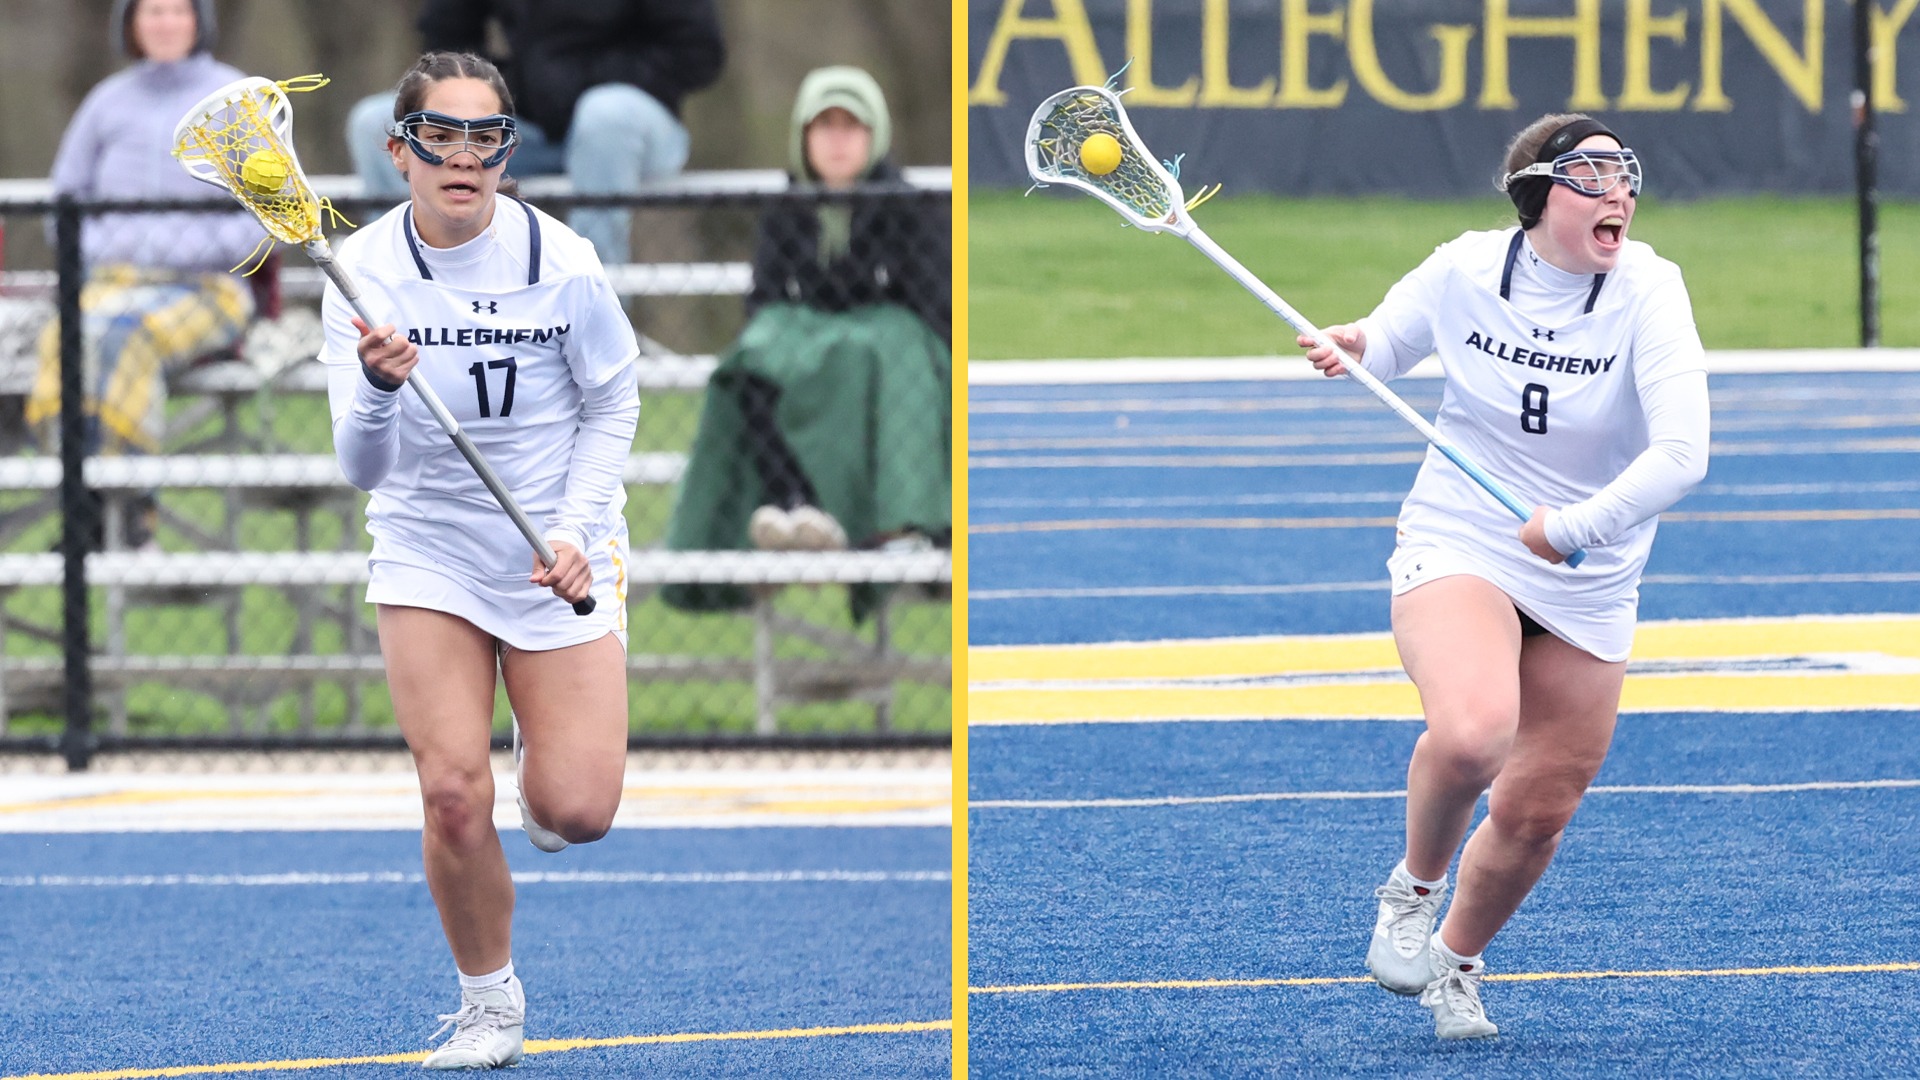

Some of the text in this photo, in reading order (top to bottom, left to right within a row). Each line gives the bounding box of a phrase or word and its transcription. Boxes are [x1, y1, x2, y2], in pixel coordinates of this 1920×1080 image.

[1465, 331, 1618, 375] ALLEGHENY
[468, 356, 518, 418] 17
[1520, 382, 1549, 435] 8
